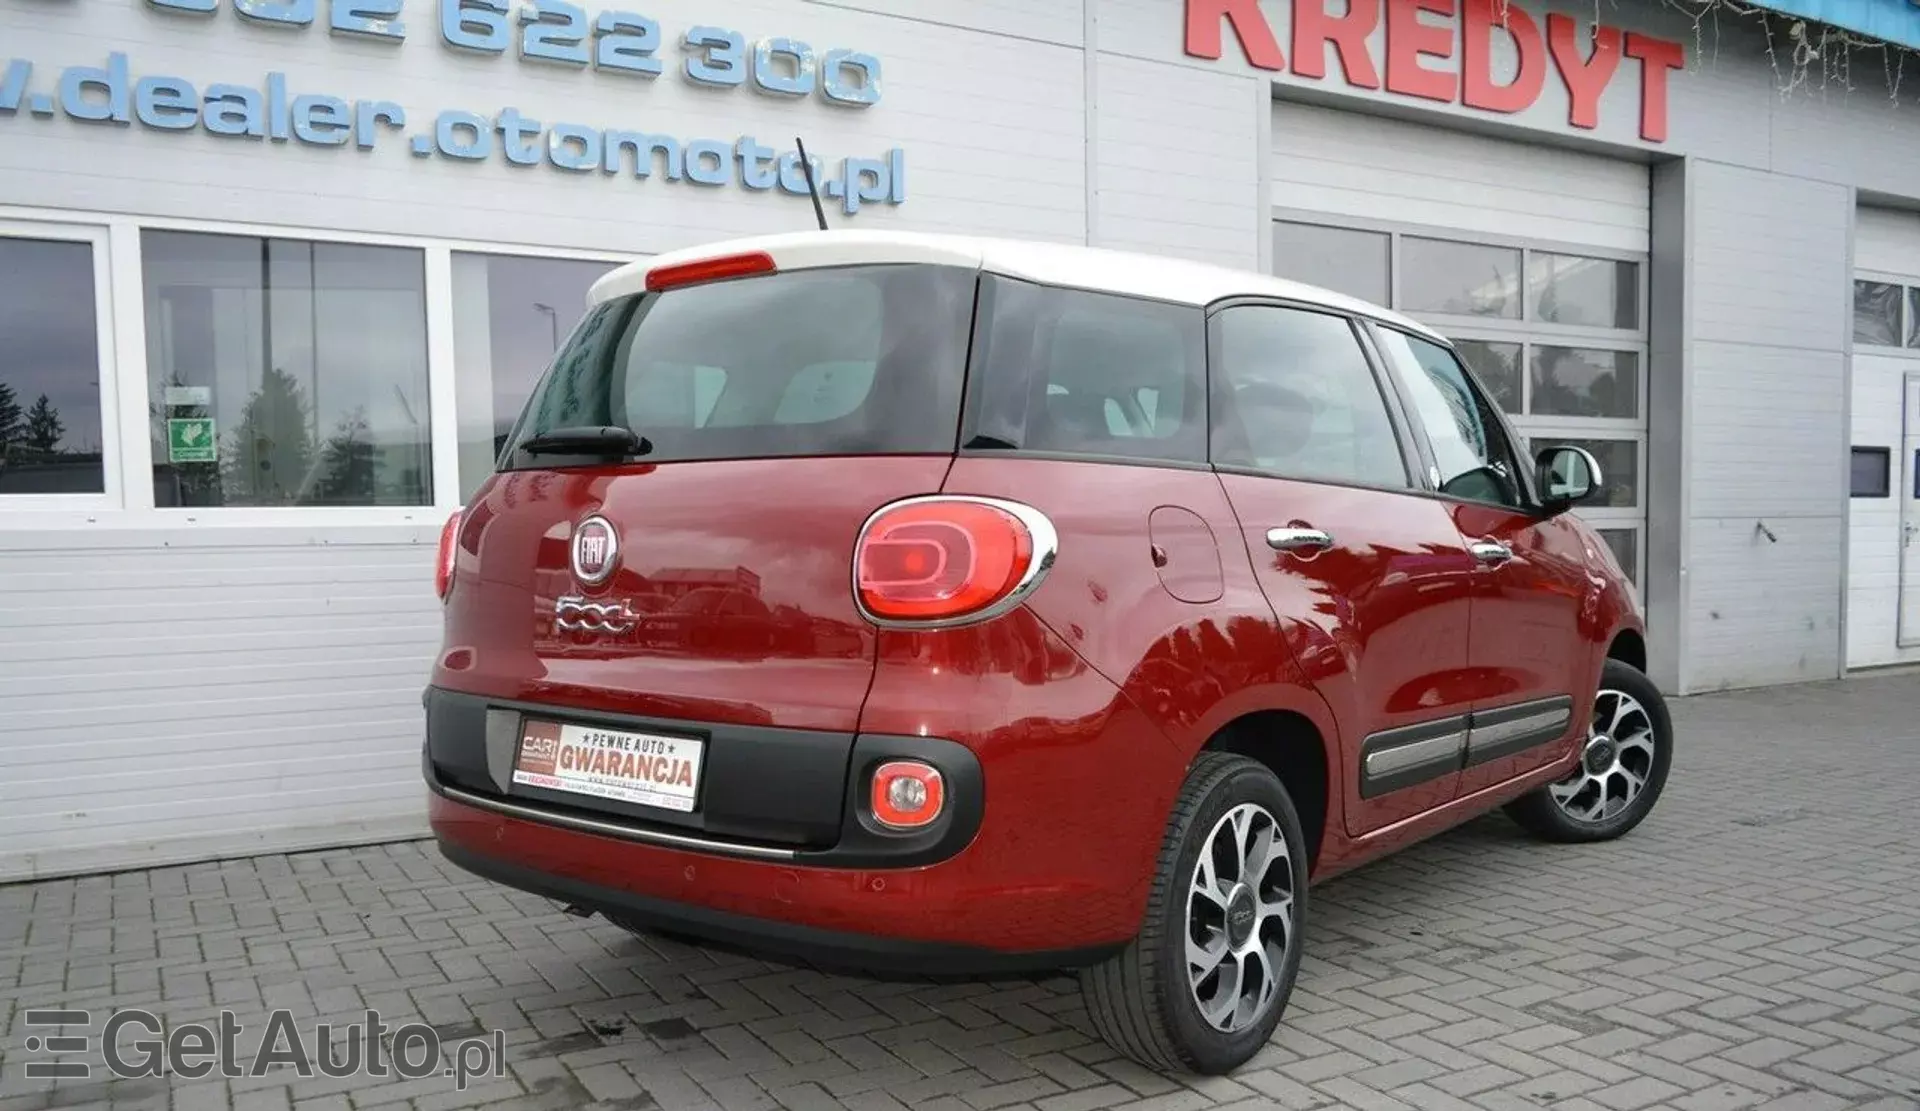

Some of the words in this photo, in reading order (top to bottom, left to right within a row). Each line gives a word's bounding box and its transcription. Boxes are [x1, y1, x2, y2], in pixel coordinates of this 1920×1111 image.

[439, 0, 662, 80] 622
[680, 24, 883, 108] 300
[1184, 0, 1685, 143] KREDYT
[580, 536, 606, 564] FIAT
[592, 732, 630, 751] PEWNE
[634, 737, 664, 755] AUTO
[559, 744, 693, 788] GWARANCJA
